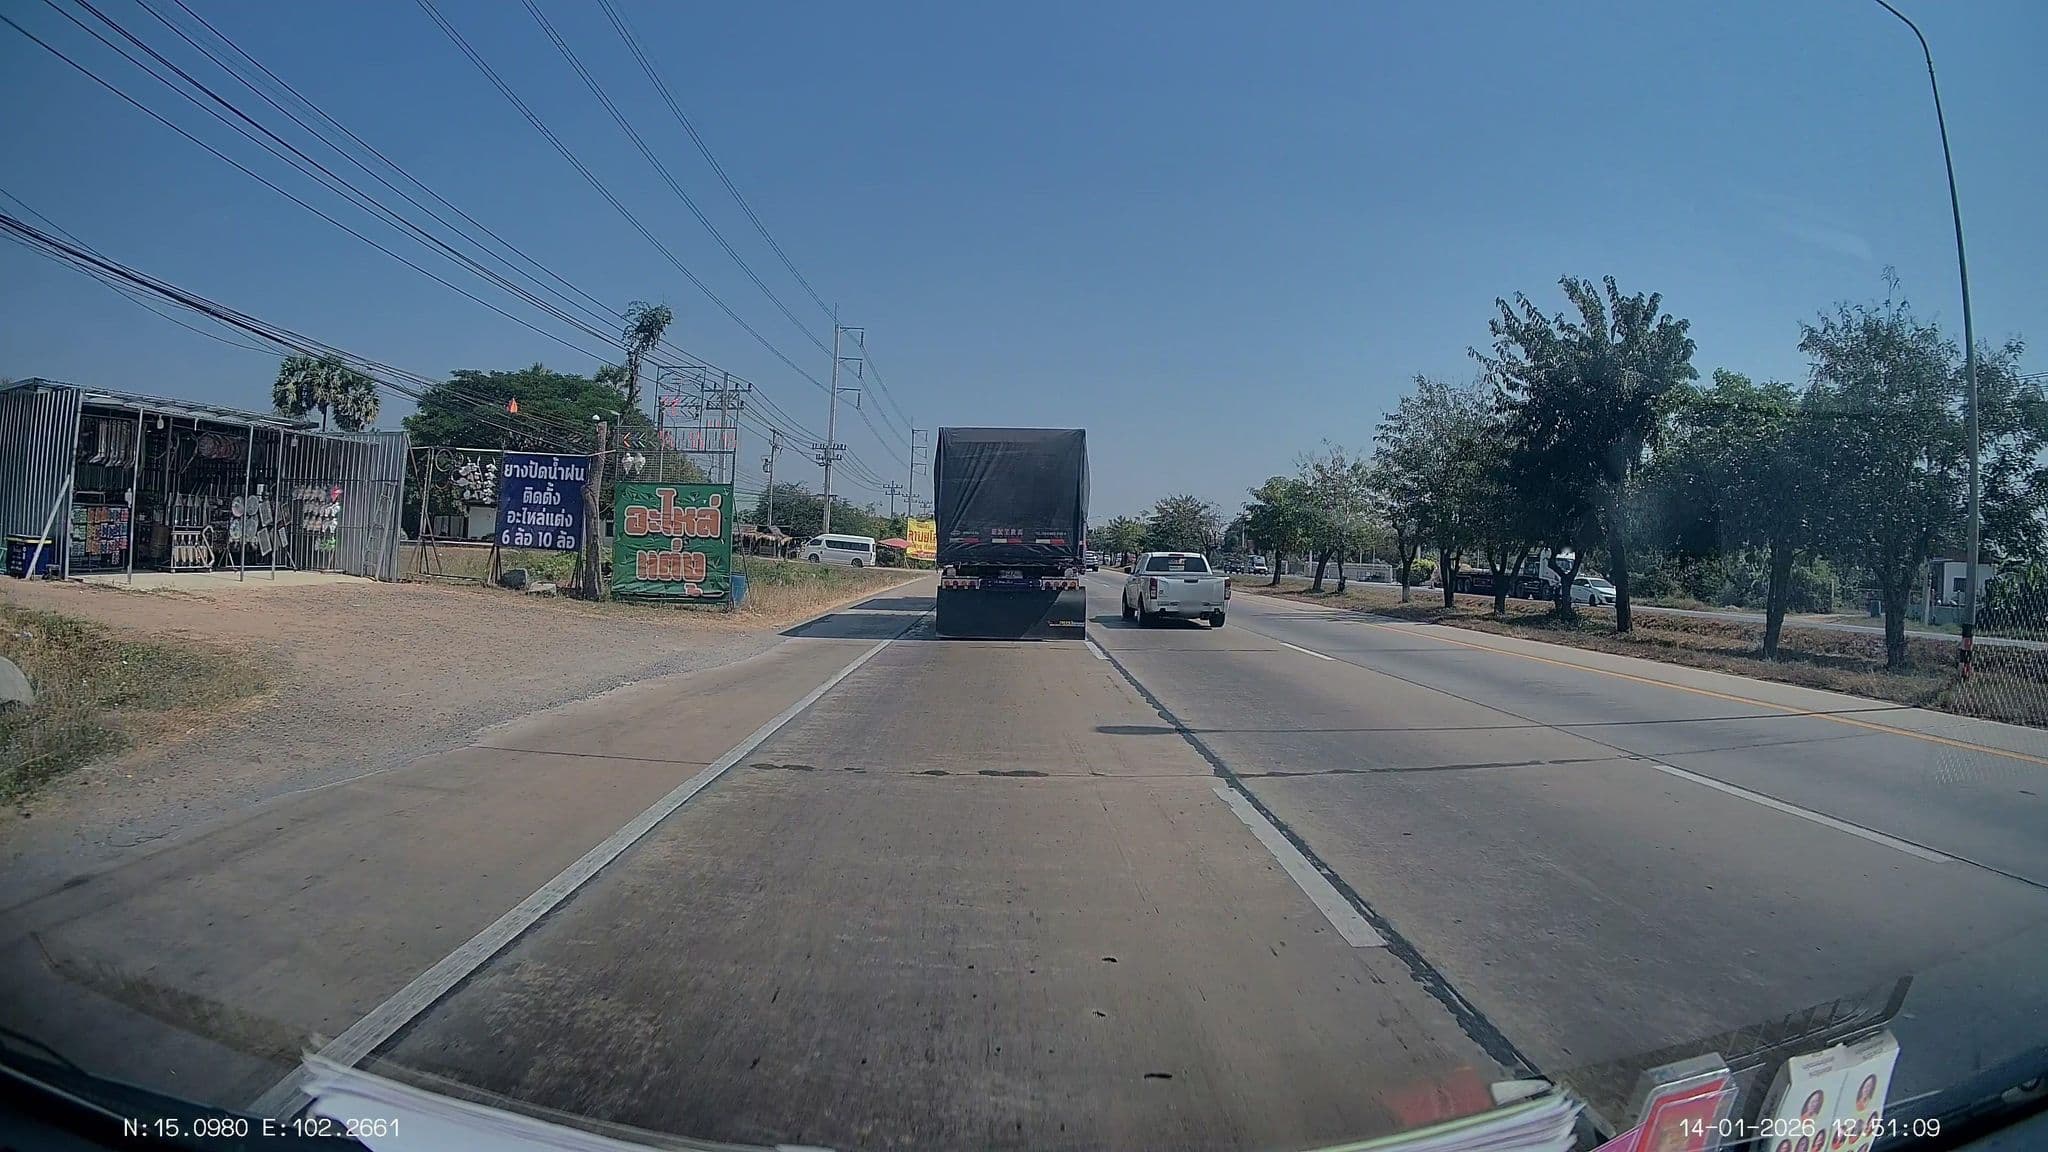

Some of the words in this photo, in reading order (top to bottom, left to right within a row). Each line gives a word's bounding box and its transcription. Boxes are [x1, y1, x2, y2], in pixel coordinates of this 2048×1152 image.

[504, 457, 585, 482] ยางปัดน้ำฝน
[522, 482, 561, 506] ติดตั้ง
[506, 507, 574, 528] อะไหล่แต่ง
[624, 487, 723, 539] อะไหล่
[501, 529, 510, 545] 6
[514, 528, 533, 546] ล้อ
[538, 531, 553, 548] 10
[556, 530, 576, 549] ล้อ
[635, 539, 706, 582] แต่ง
